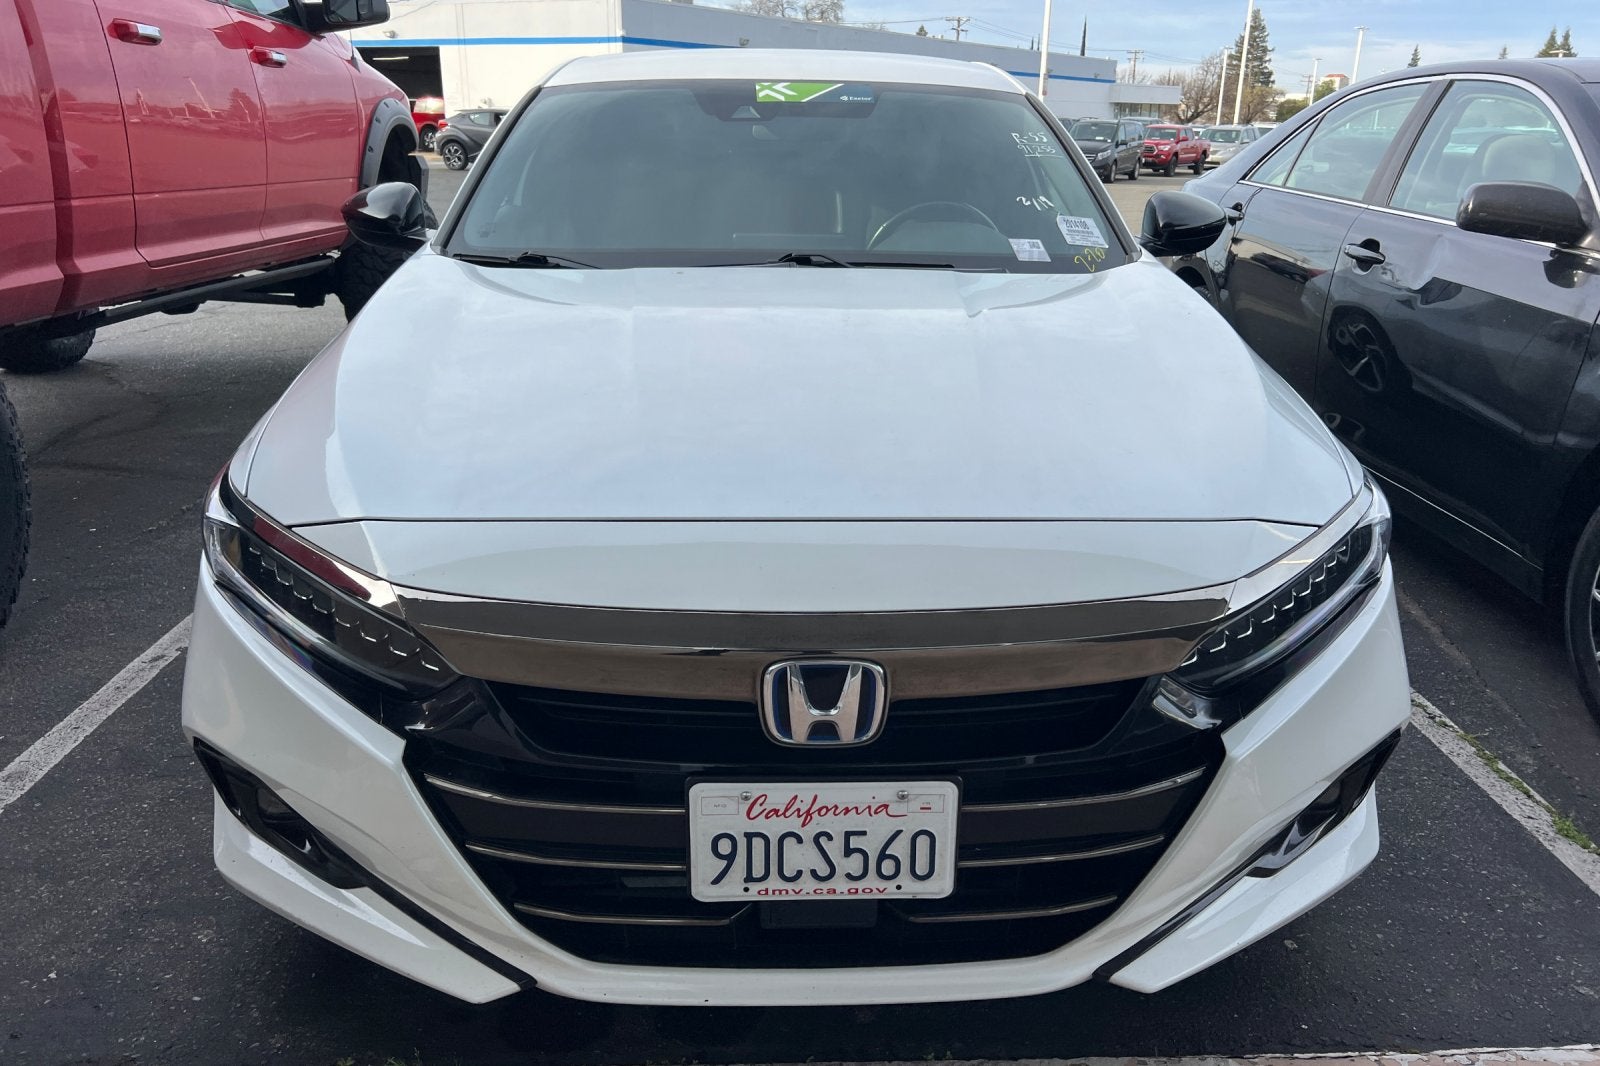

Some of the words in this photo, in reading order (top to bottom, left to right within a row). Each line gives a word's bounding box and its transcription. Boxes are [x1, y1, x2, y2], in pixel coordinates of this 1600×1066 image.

[745, 793, 907, 827] California
[710, 829, 937, 885] 9DCS560
[757, 887, 888, 896] dmv.ca.gov
